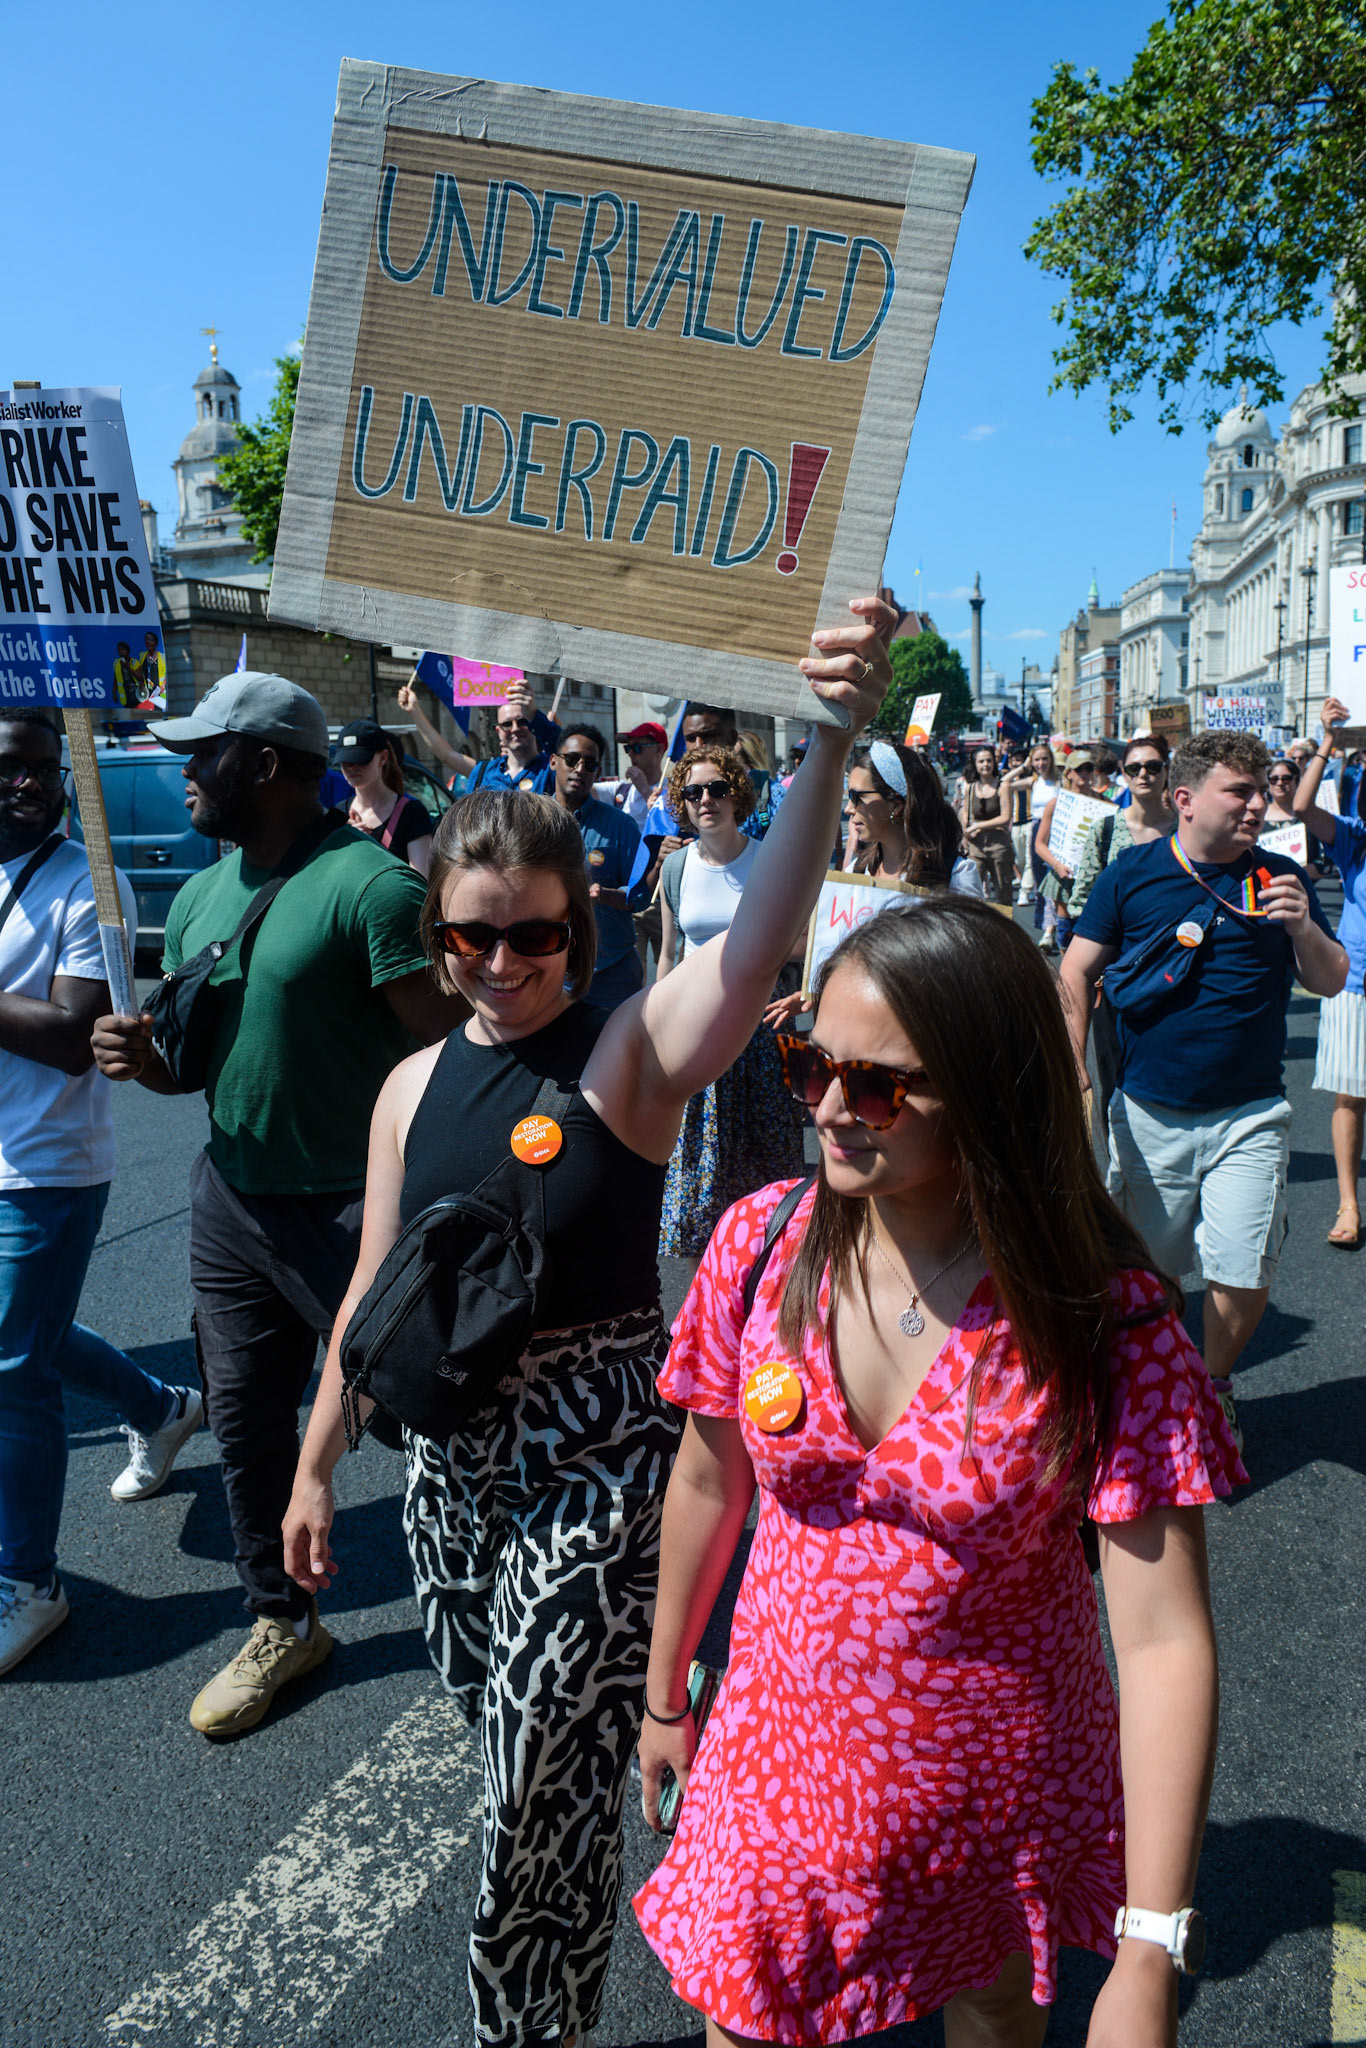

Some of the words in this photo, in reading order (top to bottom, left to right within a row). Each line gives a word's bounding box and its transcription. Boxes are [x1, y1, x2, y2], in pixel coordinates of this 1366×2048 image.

[376, 163, 896, 363] UNDERVALUED
[31, 401, 82, 420] Worker
[352, 385, 833, 576] UNDERPAID!
[26, 492, 129, 553] SAVE
[57, 555, 146, 615] NHS
[45, 634, 81, 663] out
[0, 669, 36, 698] the
[40, 669, 106, 699] Tories
[1257, 683, 1281, 696] GOOD
[914, 697, 938, 713] PAY
[1208, 698, 1225, 708] TO
[1230, 697, 1266, 708] HELL
[1207, 708, 1234, 718] WITH
[1235, 708, 1266, 717] PRAISE
[1207, 718, 1222, 727] WE
[1224, 717, 1265, 727] DESERVE
[1275, 829, 1301, 843] NEED
[513, 1121, 554, 1142] RESTORATION
[522, 1118, 539, 1131] PAY
[524, 1130, 547, 1145] NOW
[747, 1370, 791, 1401] RESTORATION
[755, 1367, 774, 1386] PAY
[758, 1383, 783, 1406] NOW
